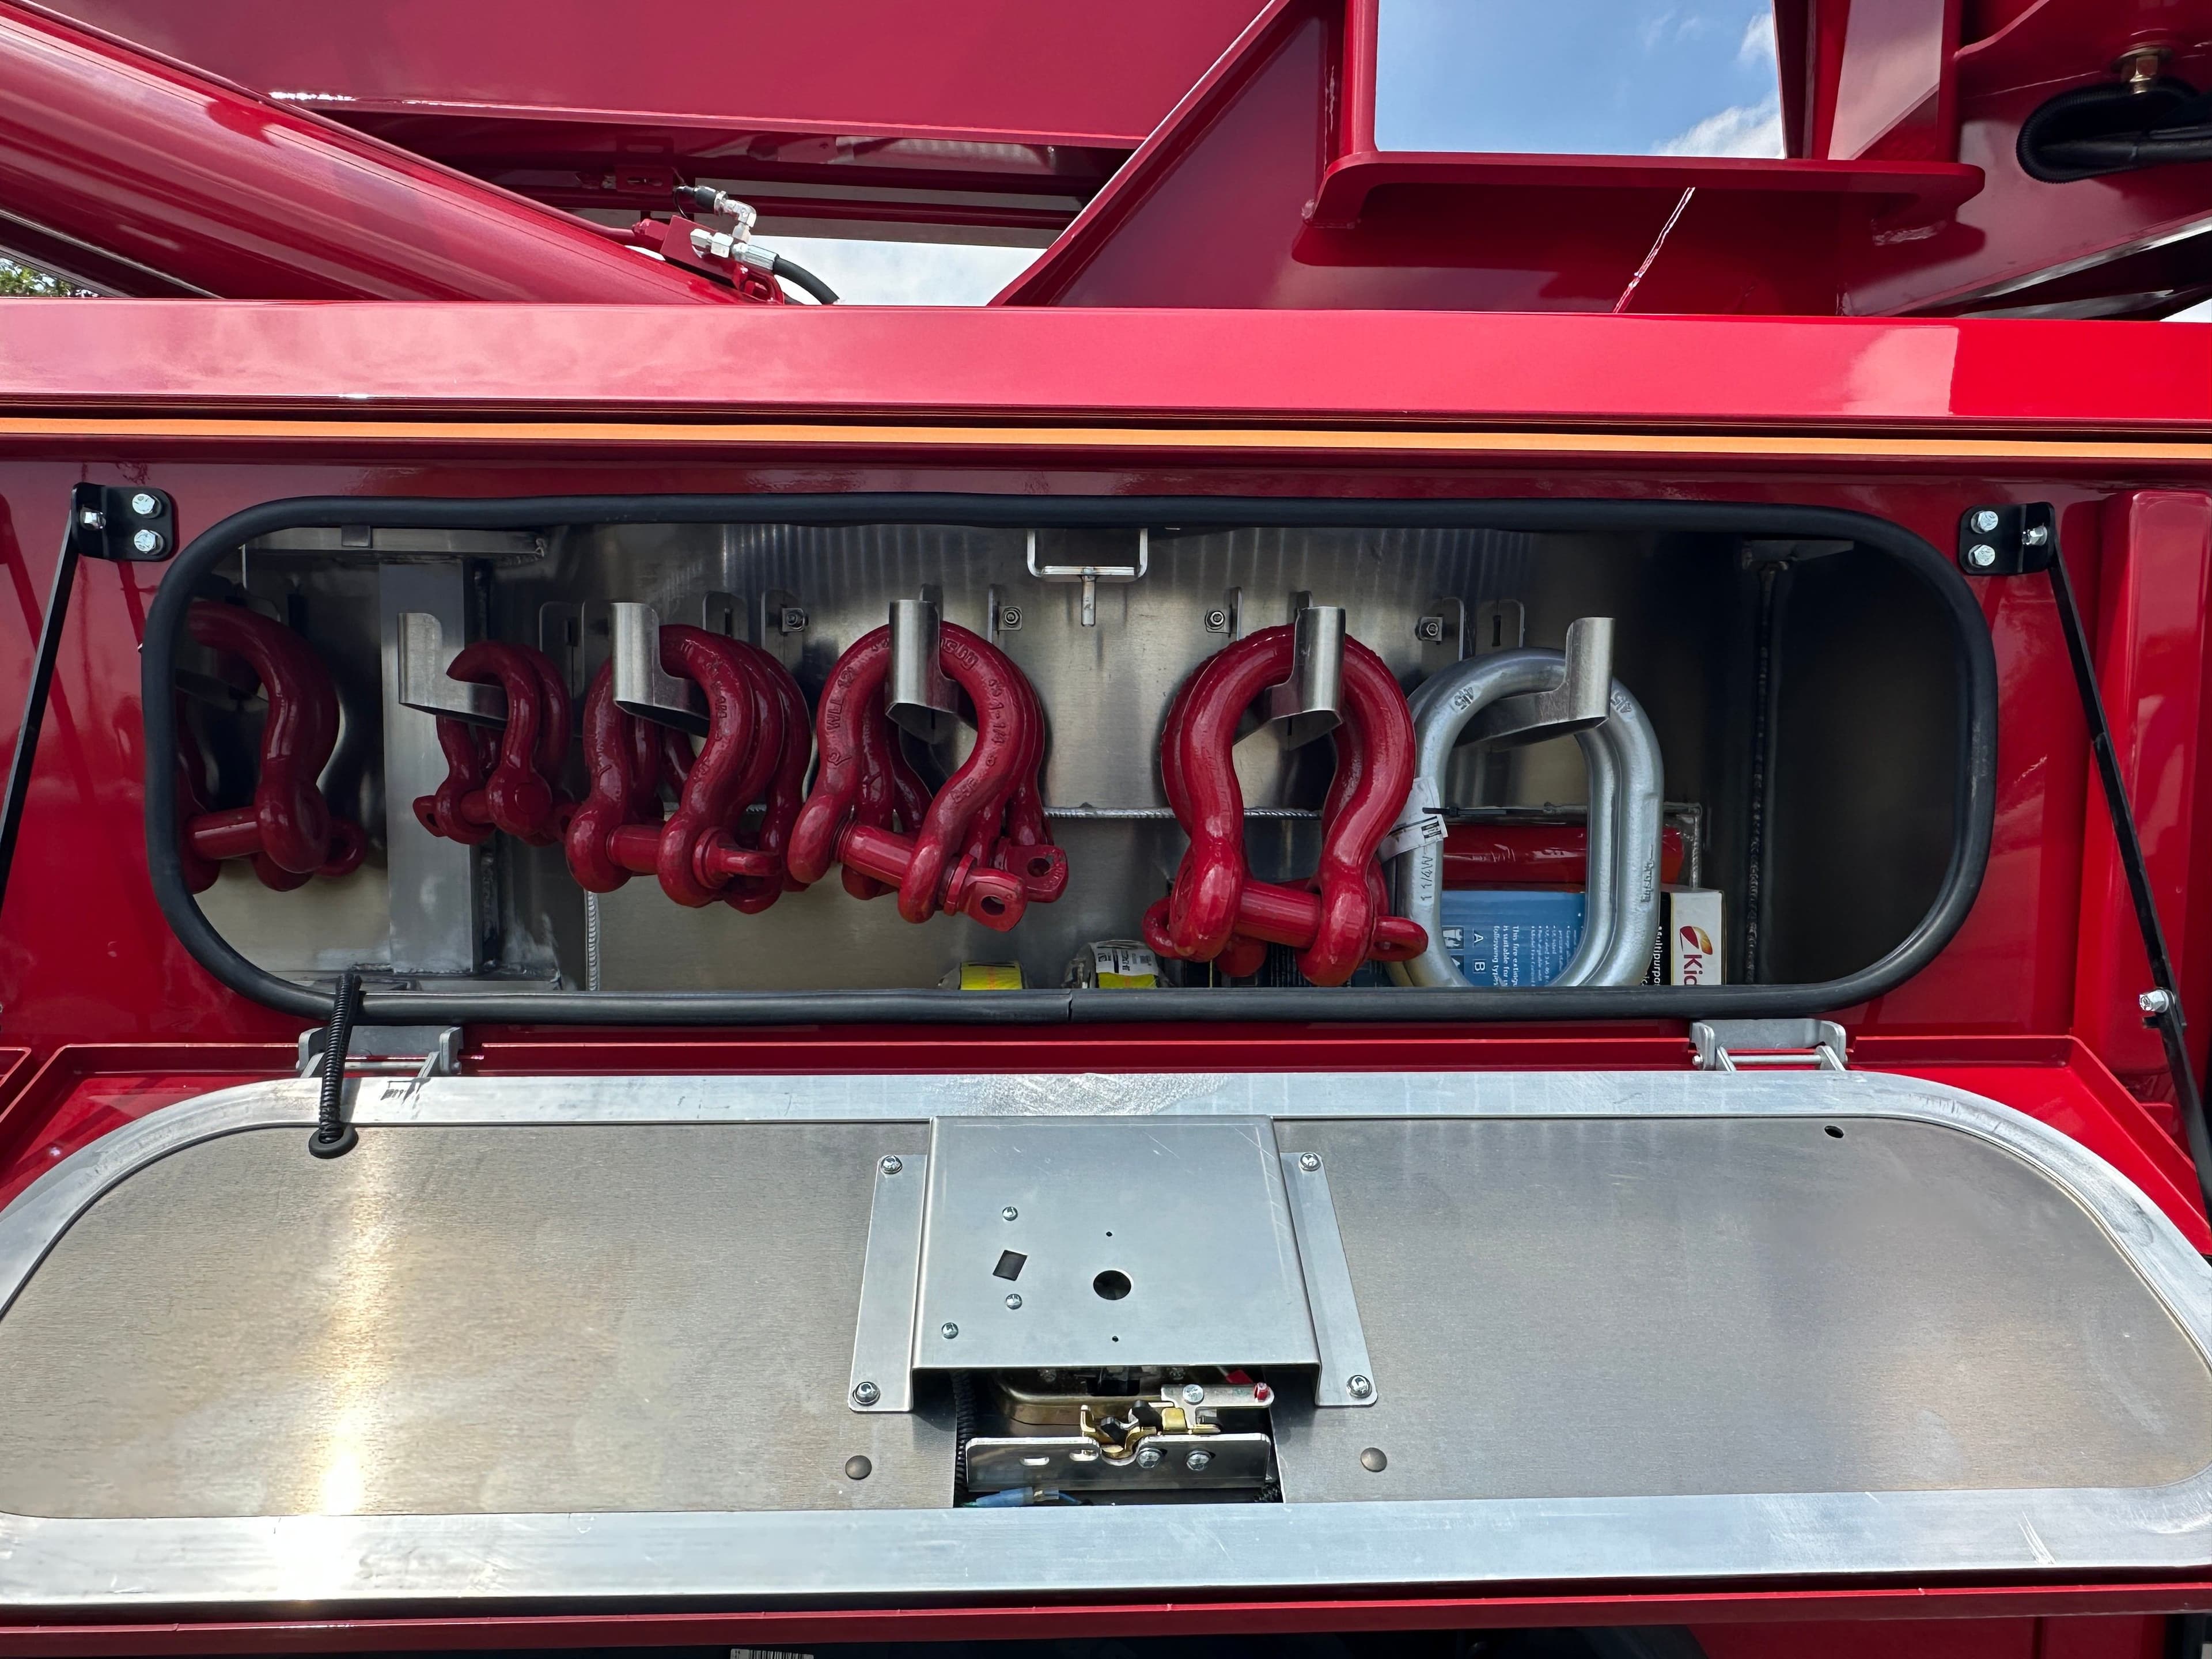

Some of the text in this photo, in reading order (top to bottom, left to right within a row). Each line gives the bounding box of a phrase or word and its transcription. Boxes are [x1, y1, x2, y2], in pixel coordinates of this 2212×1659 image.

[825, 696, 844, 730] WLL
[1474, 933, 1486, 971] A B
[1492, 926, 1500, 963] following
